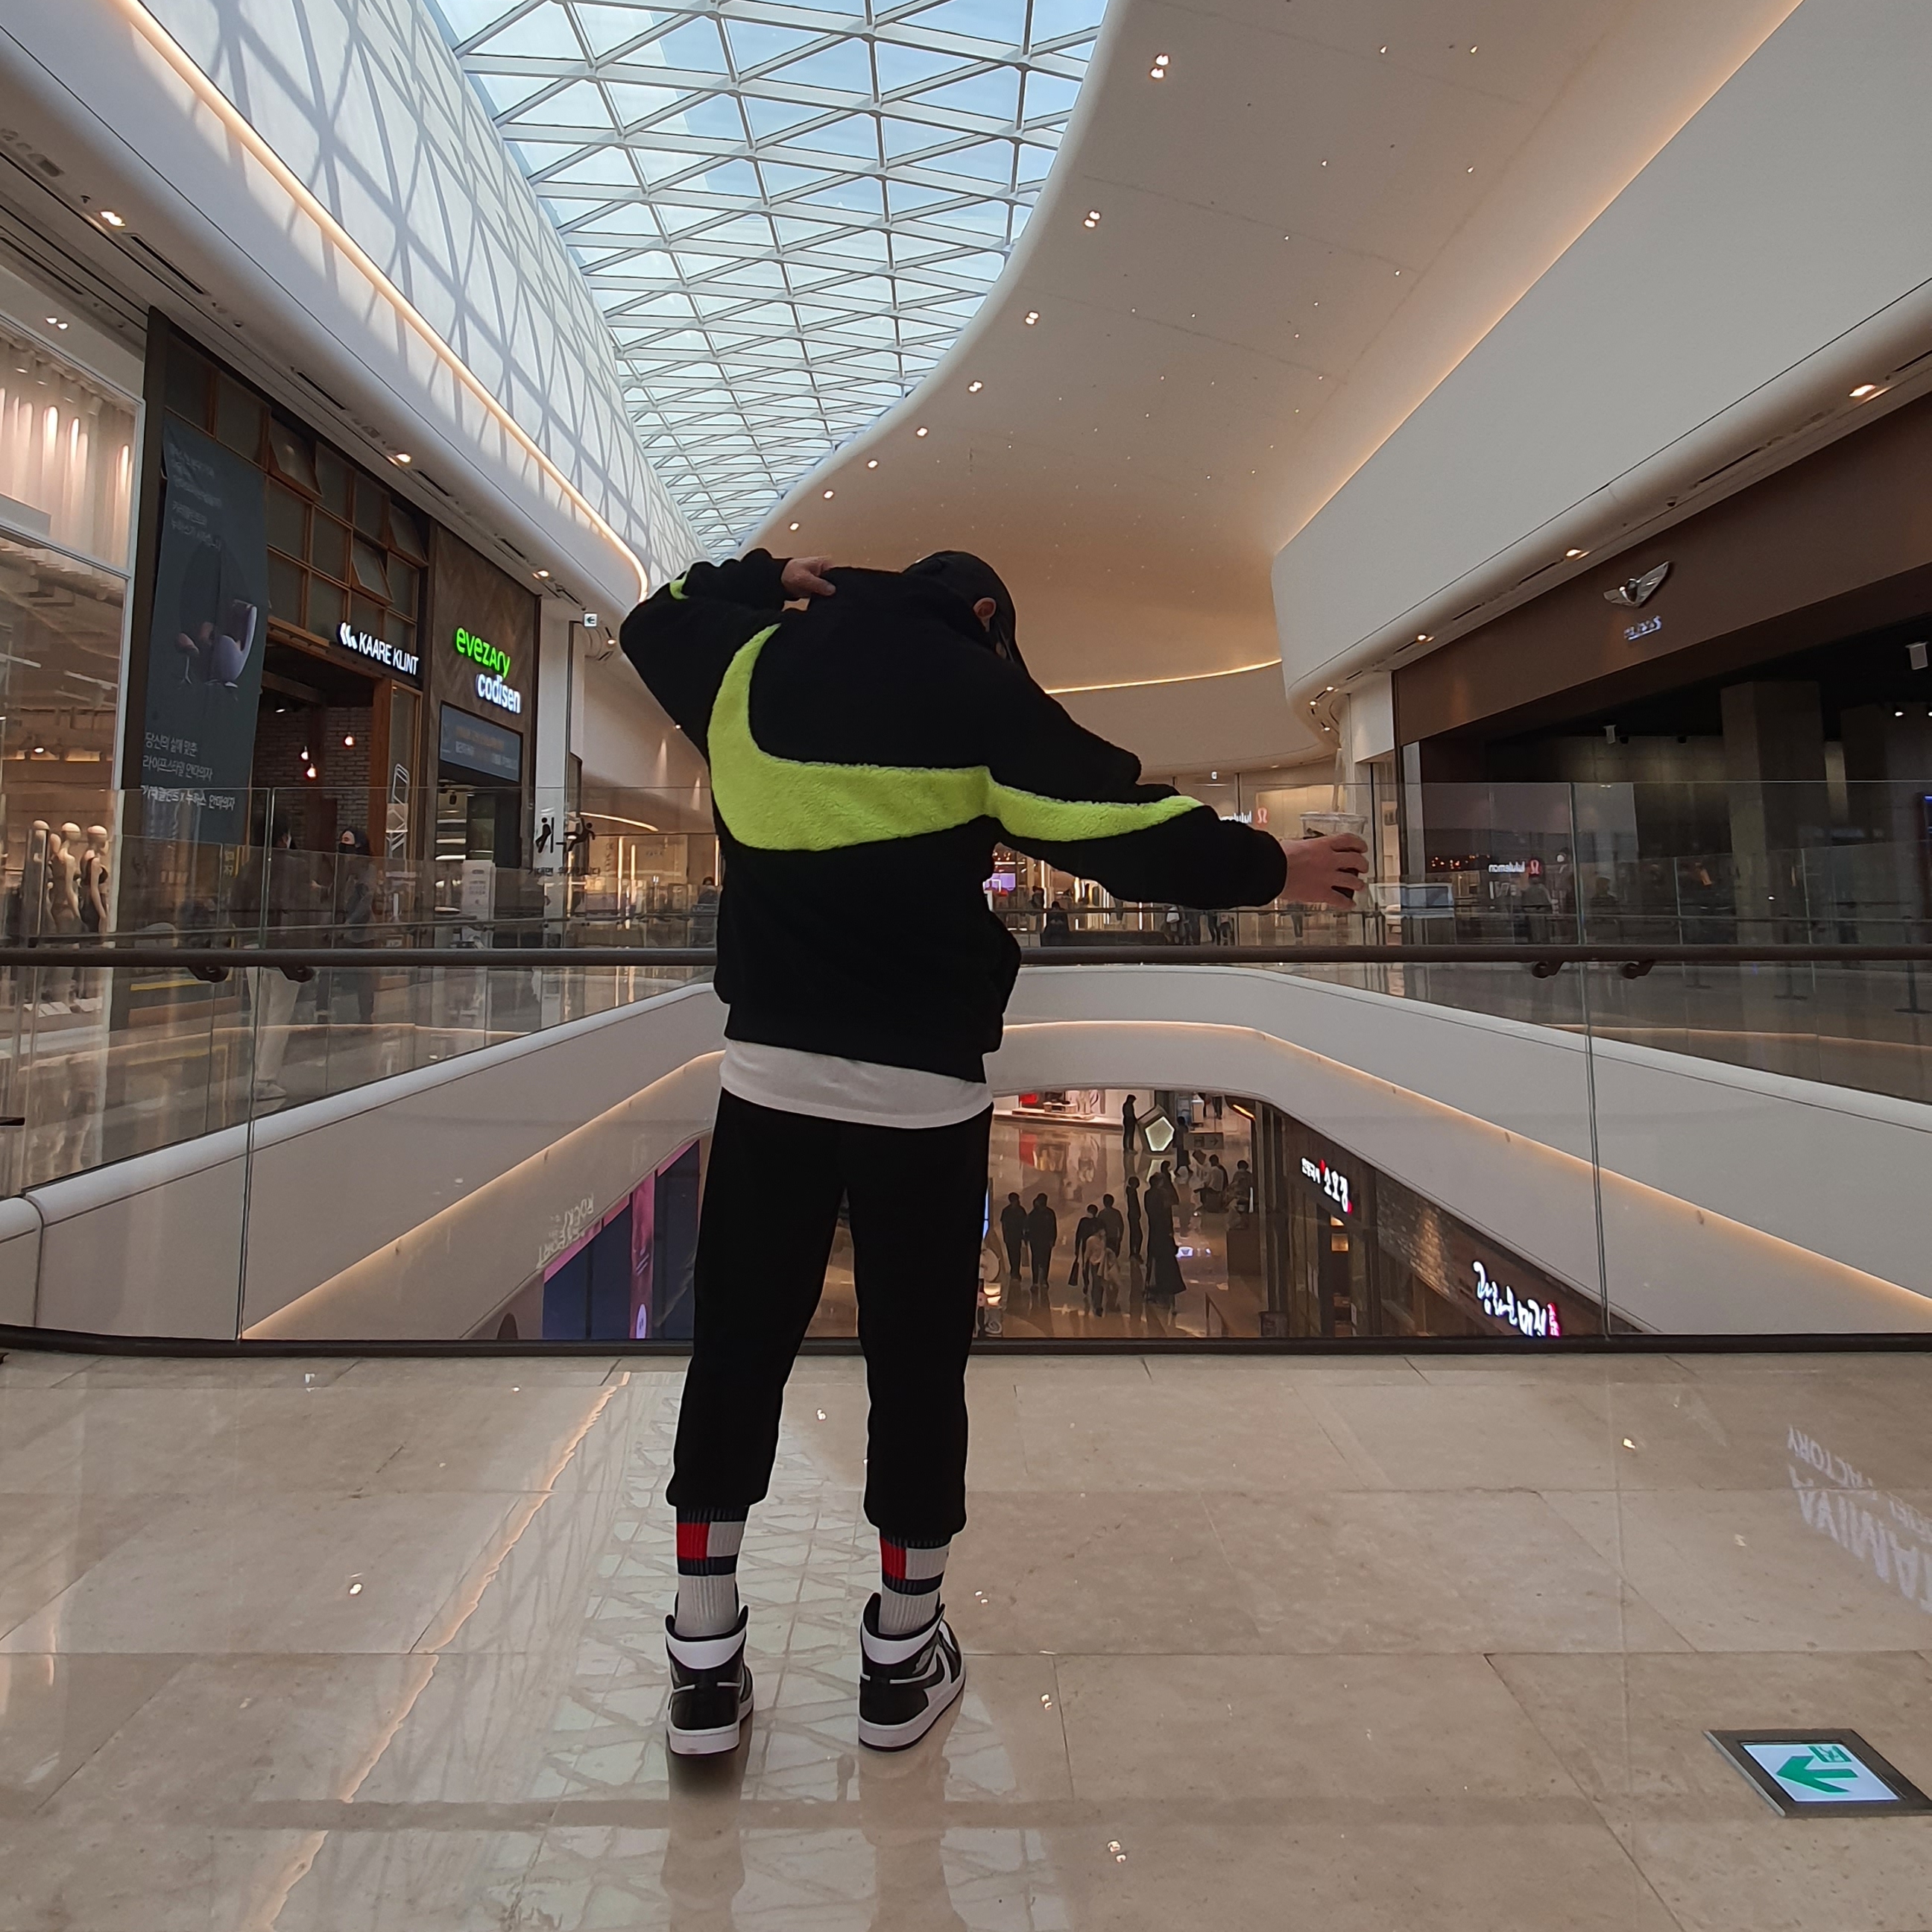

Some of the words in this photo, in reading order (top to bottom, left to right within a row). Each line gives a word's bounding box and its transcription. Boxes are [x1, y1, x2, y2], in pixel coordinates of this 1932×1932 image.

[359, 632, 392, 665] KAARE
[392, 647, 419, 675] KLINT
[476, 673, 521, 714] codisen
[145, 732, 170, 750] 당신의
[142, 754, 186, 777] 라이프스타일
[186, 763, 214, 782] 안마의자
[209, 794, 236, 811] 안마의자
